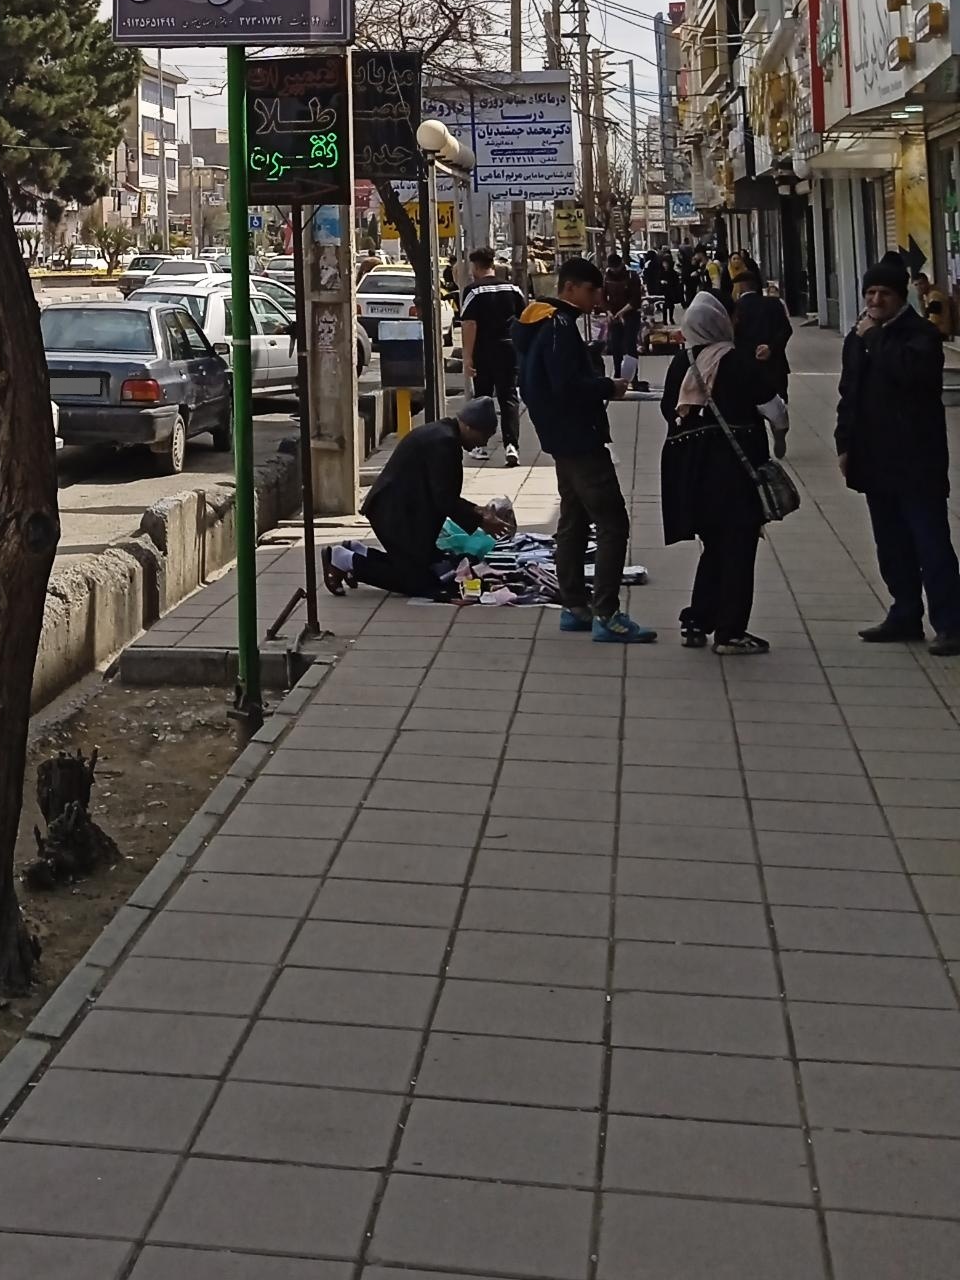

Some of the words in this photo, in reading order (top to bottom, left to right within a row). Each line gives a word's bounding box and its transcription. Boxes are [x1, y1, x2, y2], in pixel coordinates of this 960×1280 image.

[353, 58, 415, 95] موبای
[254, 97, 337, 134] طلا
[500, 109, 544, 122] درسا
[477, 124, 524, 140] جمشیدیان
[526, 126, 552, 137] محمد
[551, 124, 571, 138] دکتر
[553, 186, 574, 200] دکتر
